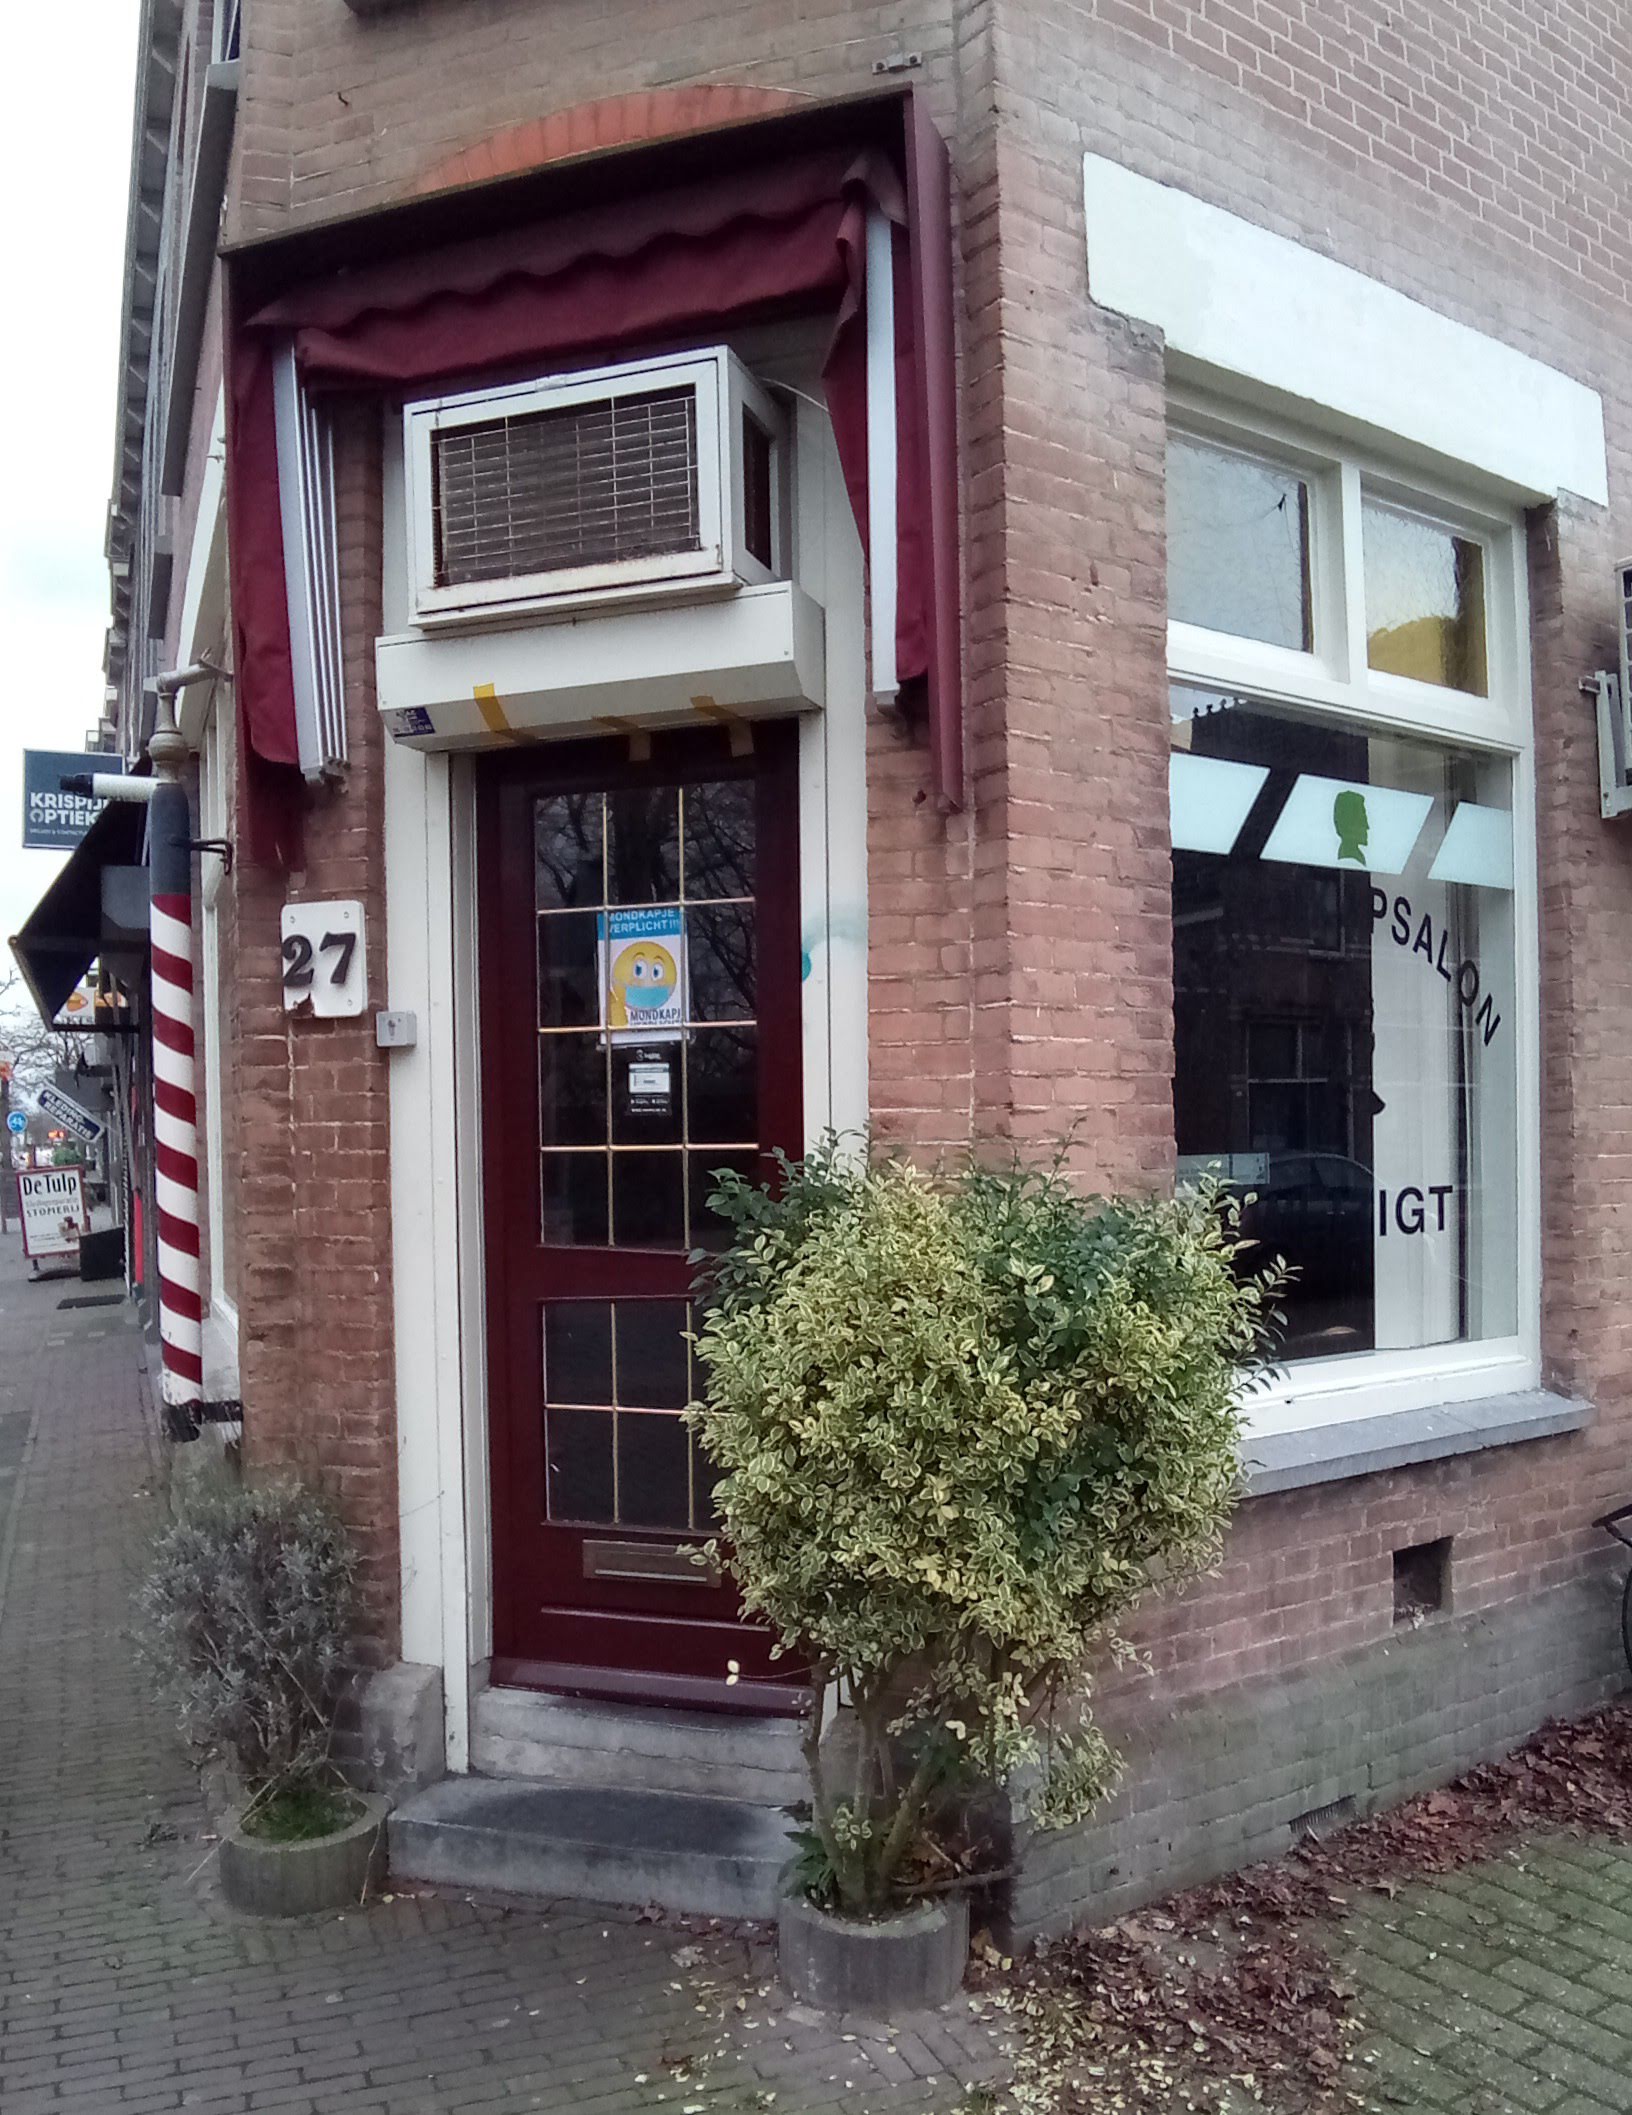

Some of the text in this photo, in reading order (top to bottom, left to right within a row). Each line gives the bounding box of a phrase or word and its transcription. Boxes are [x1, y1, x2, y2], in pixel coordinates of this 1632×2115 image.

[30, 808, 99, 826] OPTIEK
[283, 931, 357, 986] 27
[23, 1173, 77, 1195] De Tulp
